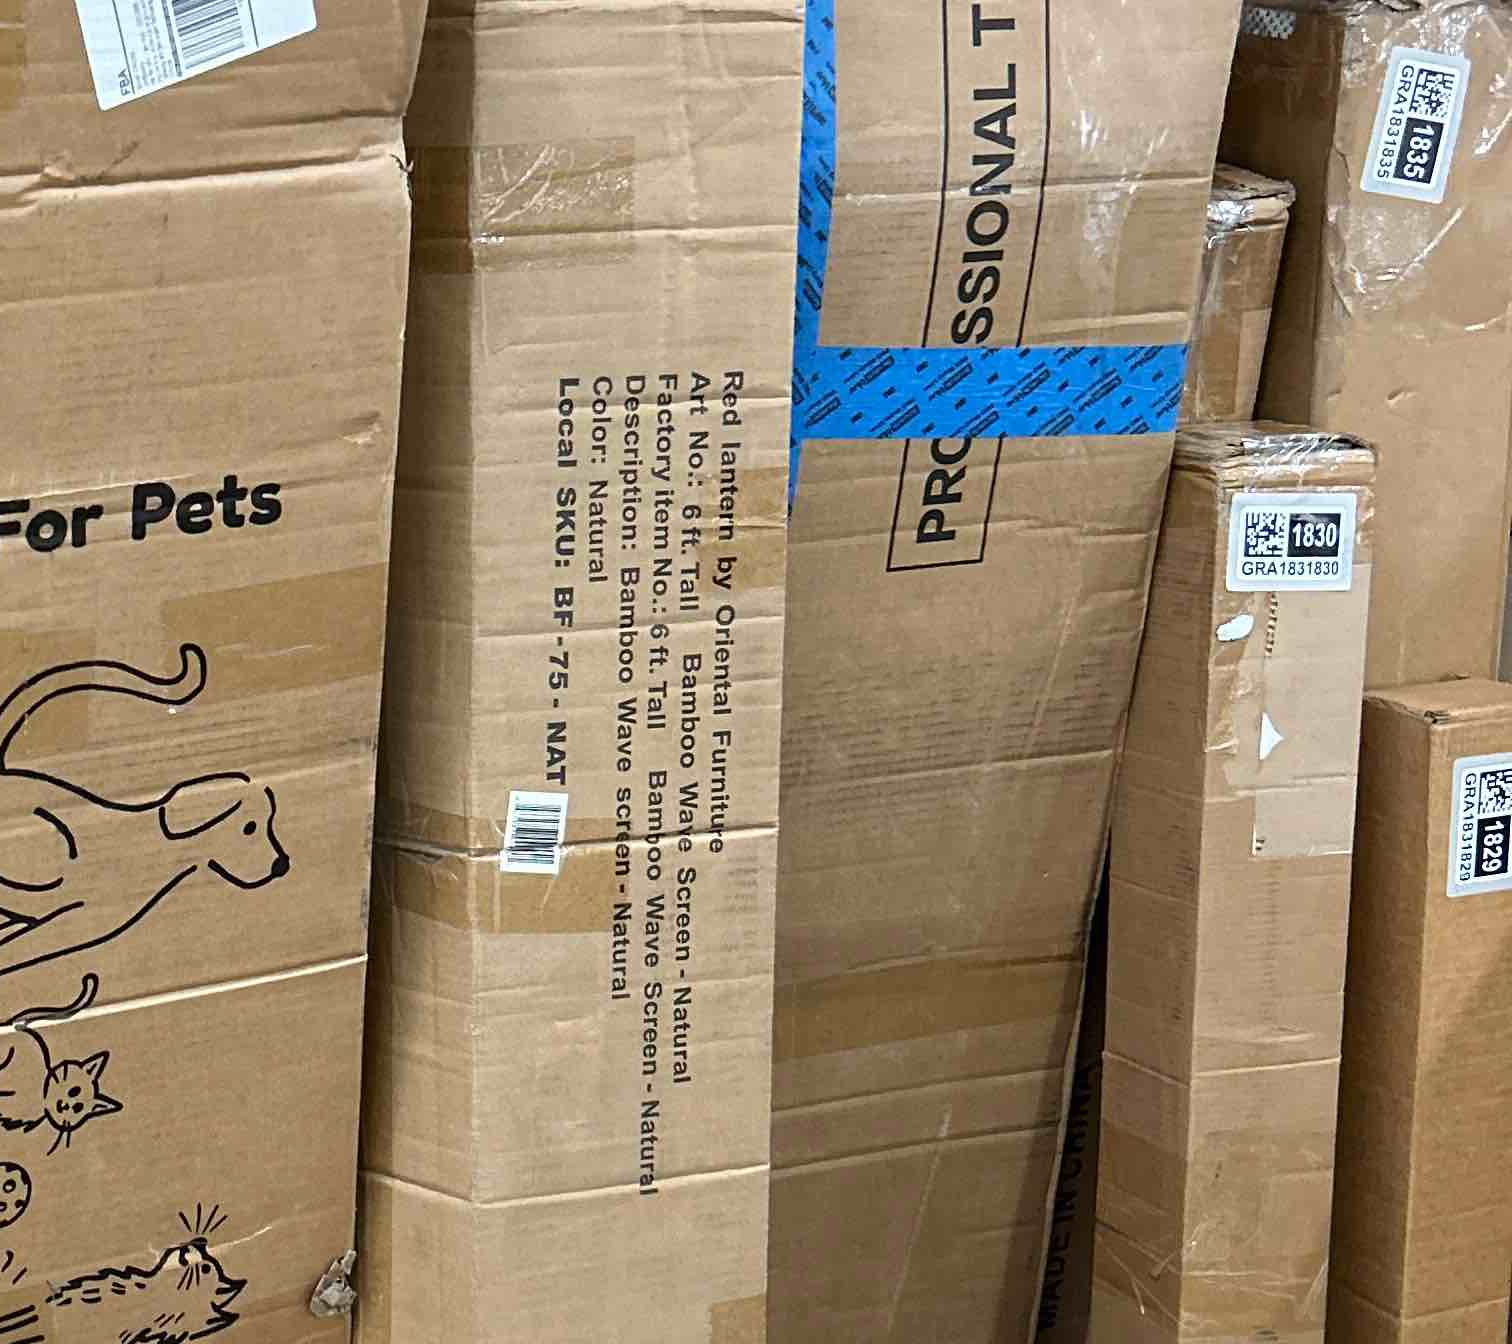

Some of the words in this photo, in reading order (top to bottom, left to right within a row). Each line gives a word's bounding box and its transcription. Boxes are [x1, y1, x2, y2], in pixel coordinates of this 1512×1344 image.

[118, 69, 129, 97] FBA
[1376, 64, 1415, 179] GRA1831835
[1402, 123, 1435, 181] 1835
[916, 64, 1016, 543] PROSSIONAL
[557, 377, 580, 467] Local
[590, 376, 613, 464] Color:
[651, 374, 678, 482] Factory
[689, 372, 711, 416] Art
[721, 370, 744, 426] Red
[619, 374, 646, 550] Description:
[688, 431, 709, 487] No.:
[718, 442, 741, 541] lantern
[131, 474, 283, 541] Pets
[555, 487, 577, 567] SKU:
[587, 480, 609, 583] Natural
[654, 489, 675, 550] item
[681, 504, 702, 519] 6
[681, 528, 702, 555] ft.
[1292, 522, 1338, 548] 1830
[652, 558, 673, 613] No.:
[679, 563, 700, 611] Tall
[713, 556, 738, 590] by
[1241, 561, 1339, 576] GRA1831830
[618, 567, 640, 684] Bamboo
[648, 646, 669, 674] ft.
[649, 623, 669, 639] 6
[712, 604, 736, 716] Oriental
[616, 697, 638, 773] Wave
[647, 680, 667, 729] Tall
[679, 653, 702, 769] Bamboo
[645, 770, 668, 881] Bamboo
[677, 782, 699, 854] Wave
[709, 730, 732, 854] Furniture
[1459, 772, 1478, 882] GRA1831829
[615, 787, 632, 876] screen
[1481, 820, 1505, 873] 1829
[611, 902, 633, 1000] Natural
[643, 893, 665, 968] Wave
[675, 866, 696, 961] Screen
[641, 982, 663, 1076] Screen
[672, 988, 692, 1084] Natural
[639, 1100, 659, 1196] Natural
